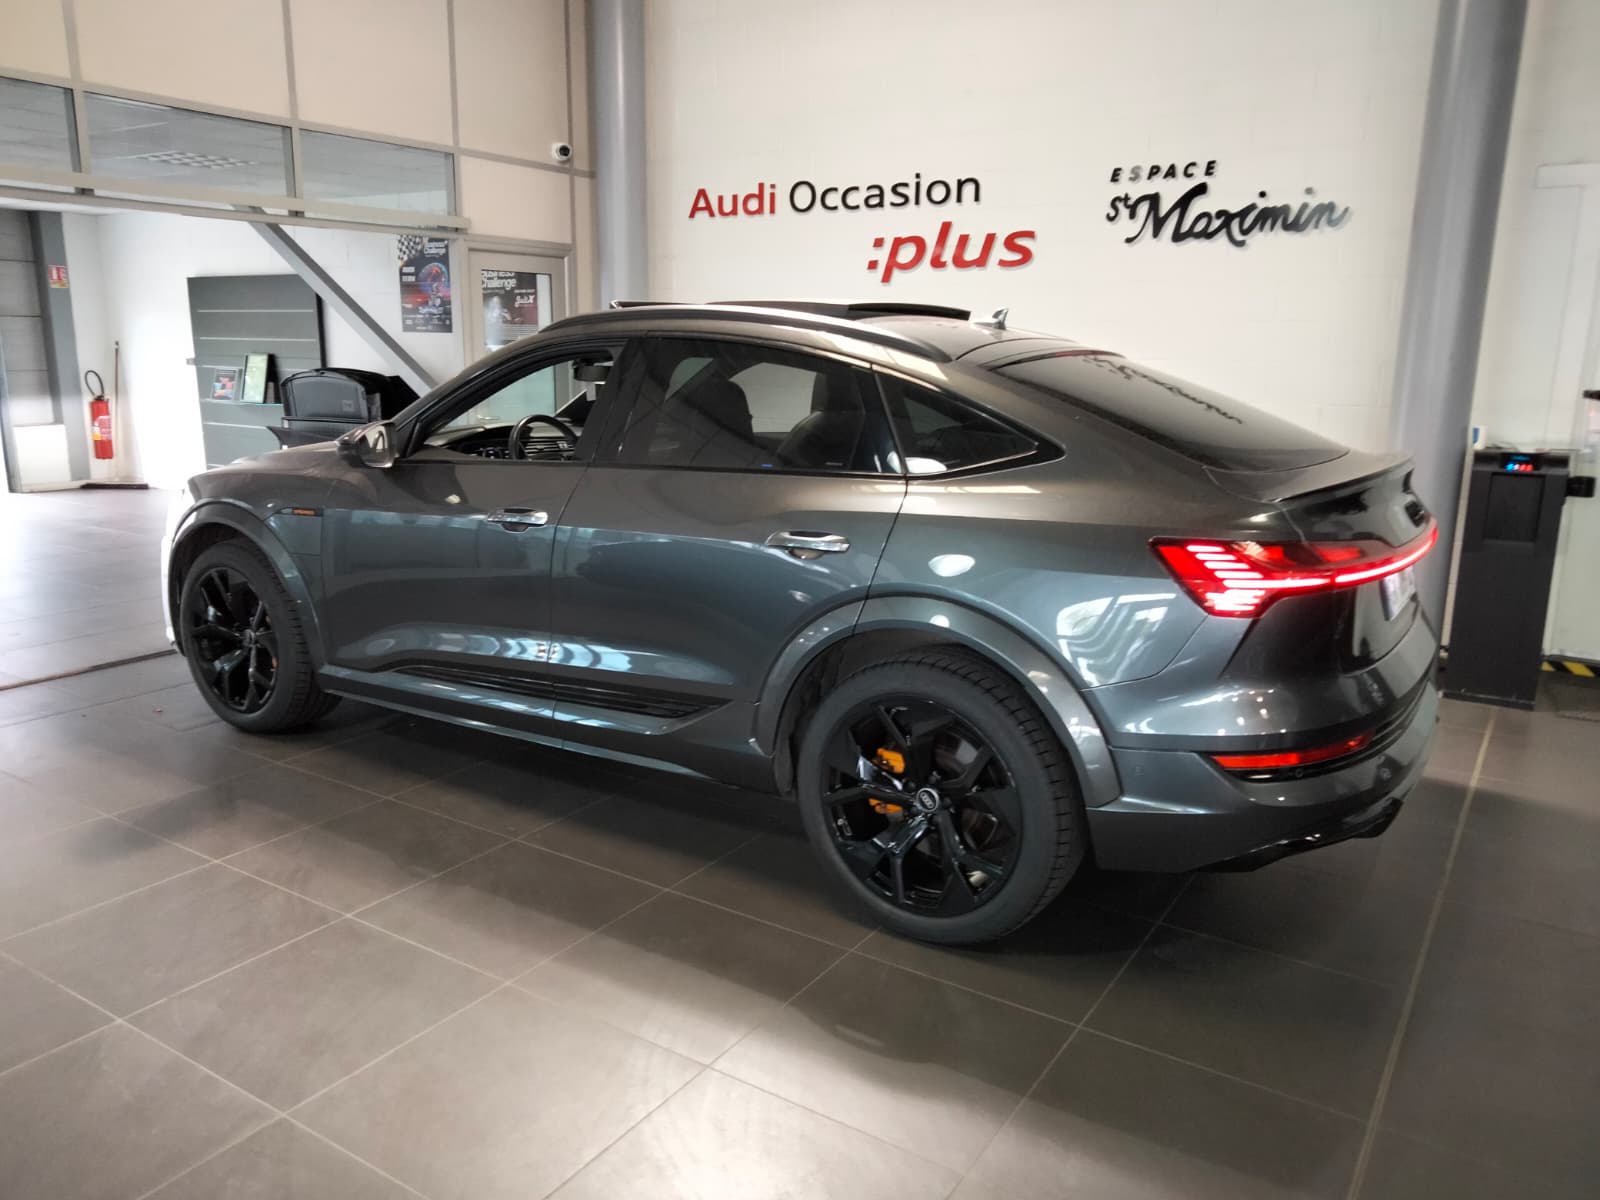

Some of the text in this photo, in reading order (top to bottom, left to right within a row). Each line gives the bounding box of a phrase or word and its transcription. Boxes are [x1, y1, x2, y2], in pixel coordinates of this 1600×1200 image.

[688, 172, 981, 219] Audi Occasion
[1109, 159, 1217, 183] ESPACE
[1124, 181, 1351, 248] Maximin
[867, 221, 1036, 283] :plus
